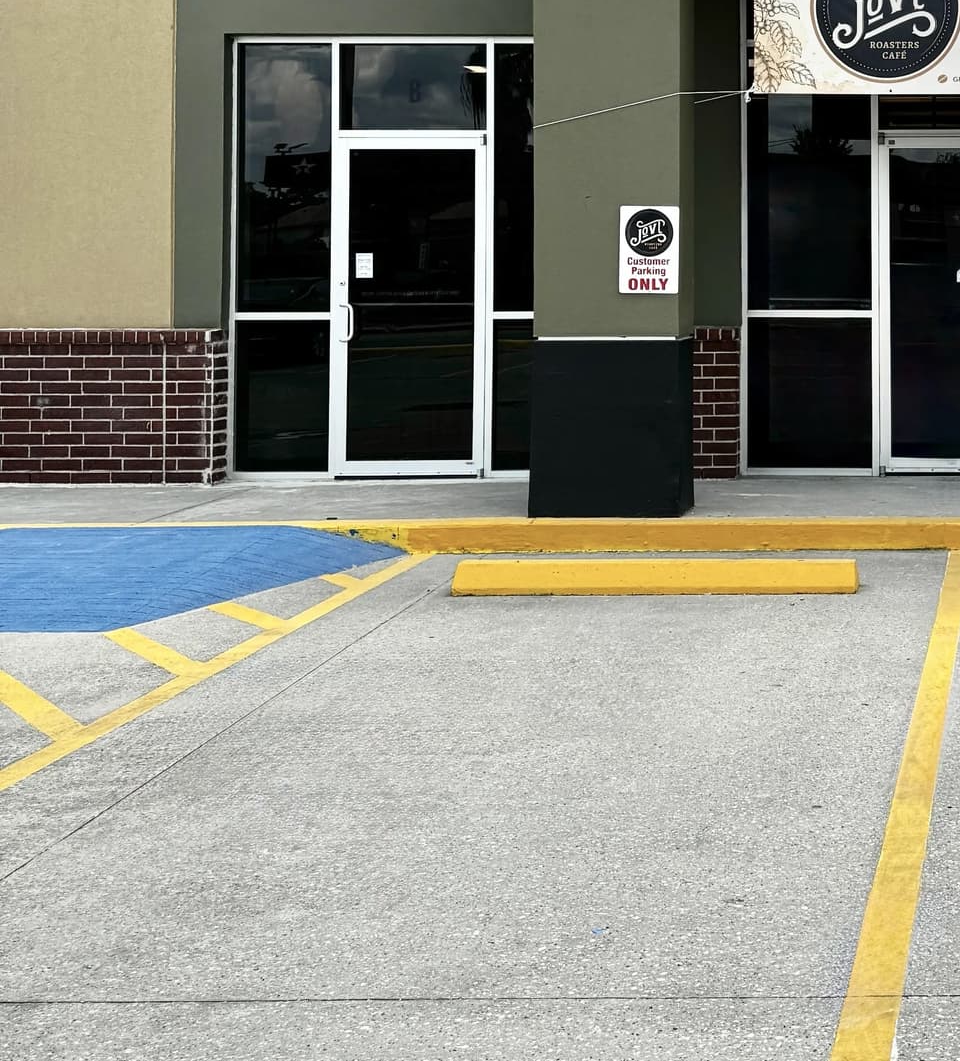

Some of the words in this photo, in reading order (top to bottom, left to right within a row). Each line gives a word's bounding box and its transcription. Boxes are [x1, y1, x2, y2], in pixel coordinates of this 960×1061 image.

[870, 41, 919, 49] ROASTERS
[882, 51, 907, 60] CAFÉ
[627, 257, 670, 266] Customer
[631, 266, 666, 276] Parking
[628, 278, 669, 291] ONLY
